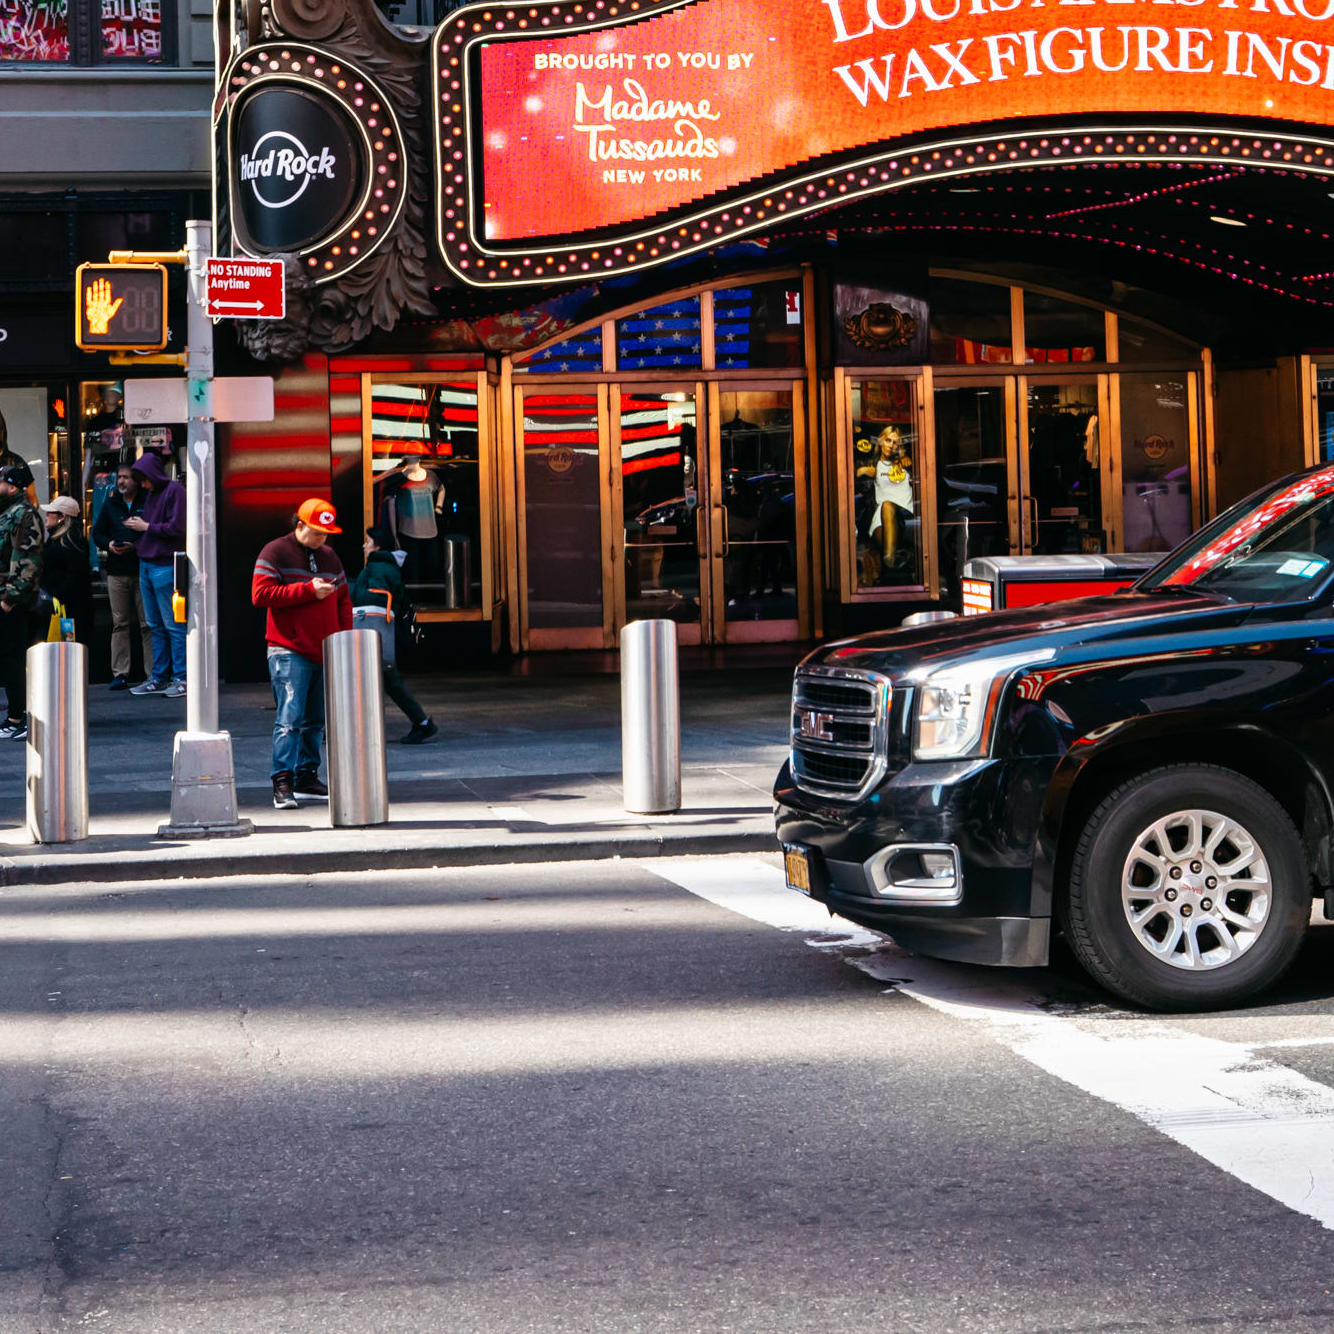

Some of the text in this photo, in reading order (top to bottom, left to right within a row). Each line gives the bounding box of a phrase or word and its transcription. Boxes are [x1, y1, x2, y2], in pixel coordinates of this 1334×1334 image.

[534, 52, 754, 70] BROUGHT TO YOU BY
[833, 39, 985, 108] WAX
[982, 26, 1214, 79] FIGURE
[575, 78, 720, 122] Madame
[573, 119, 719, 162] Tussauds
[241, 147, 336, 181] Hard Rock
[603, 169, 702, 183] NEW YORK
[210, 265, 272, 277] NO STANDING
[211, 279, 250, 291] Anytime
[800, 711, 834, 741] GMC
